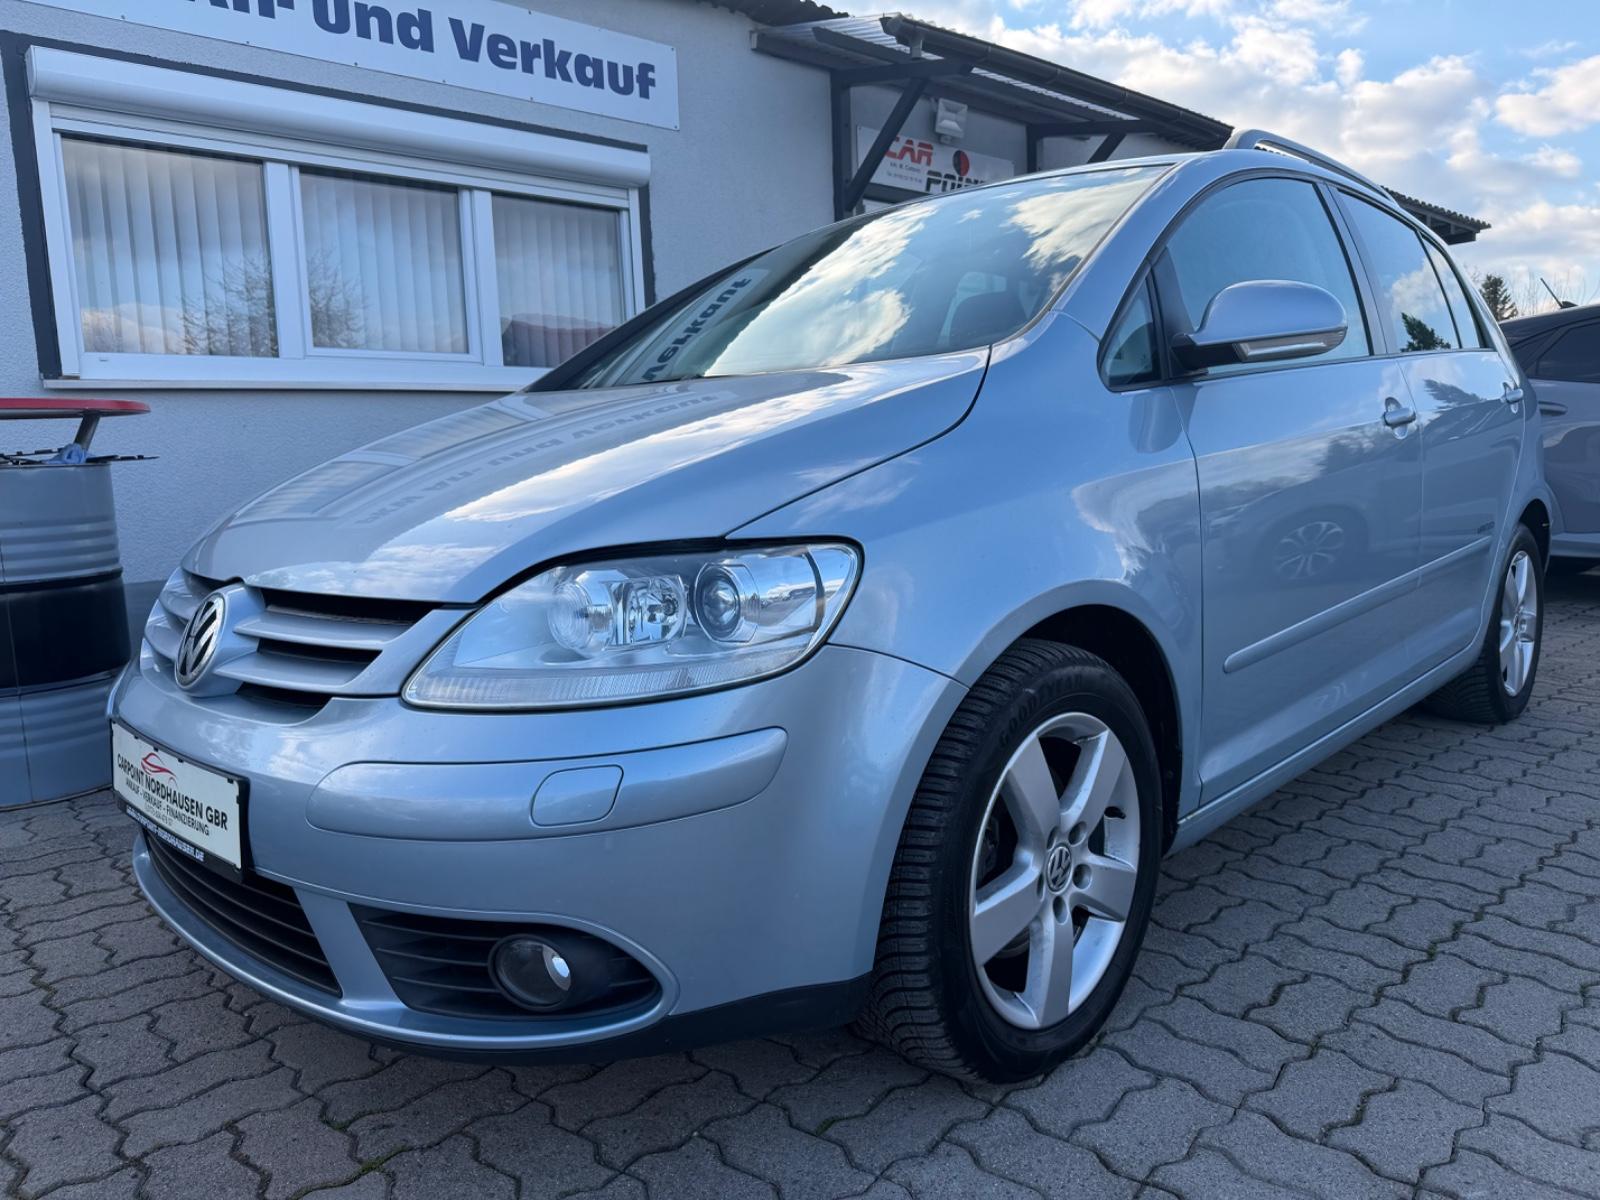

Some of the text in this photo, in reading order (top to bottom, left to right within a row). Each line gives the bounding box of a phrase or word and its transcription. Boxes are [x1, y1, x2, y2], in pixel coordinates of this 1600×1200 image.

[448, 17, 656, 100] Verkauf
[925, 170, 987, 193] POI
[175, 592, 225, 687] VW
[117, 754, 144, 786] CARPOINT
[145, 773, 203, 818] NORDHAUSEN
[205, 806, 228, 831] GBR
[142, 791, 162, 811] VERKAUF
[166, 804, 209, 836] FINANZIERUNG
